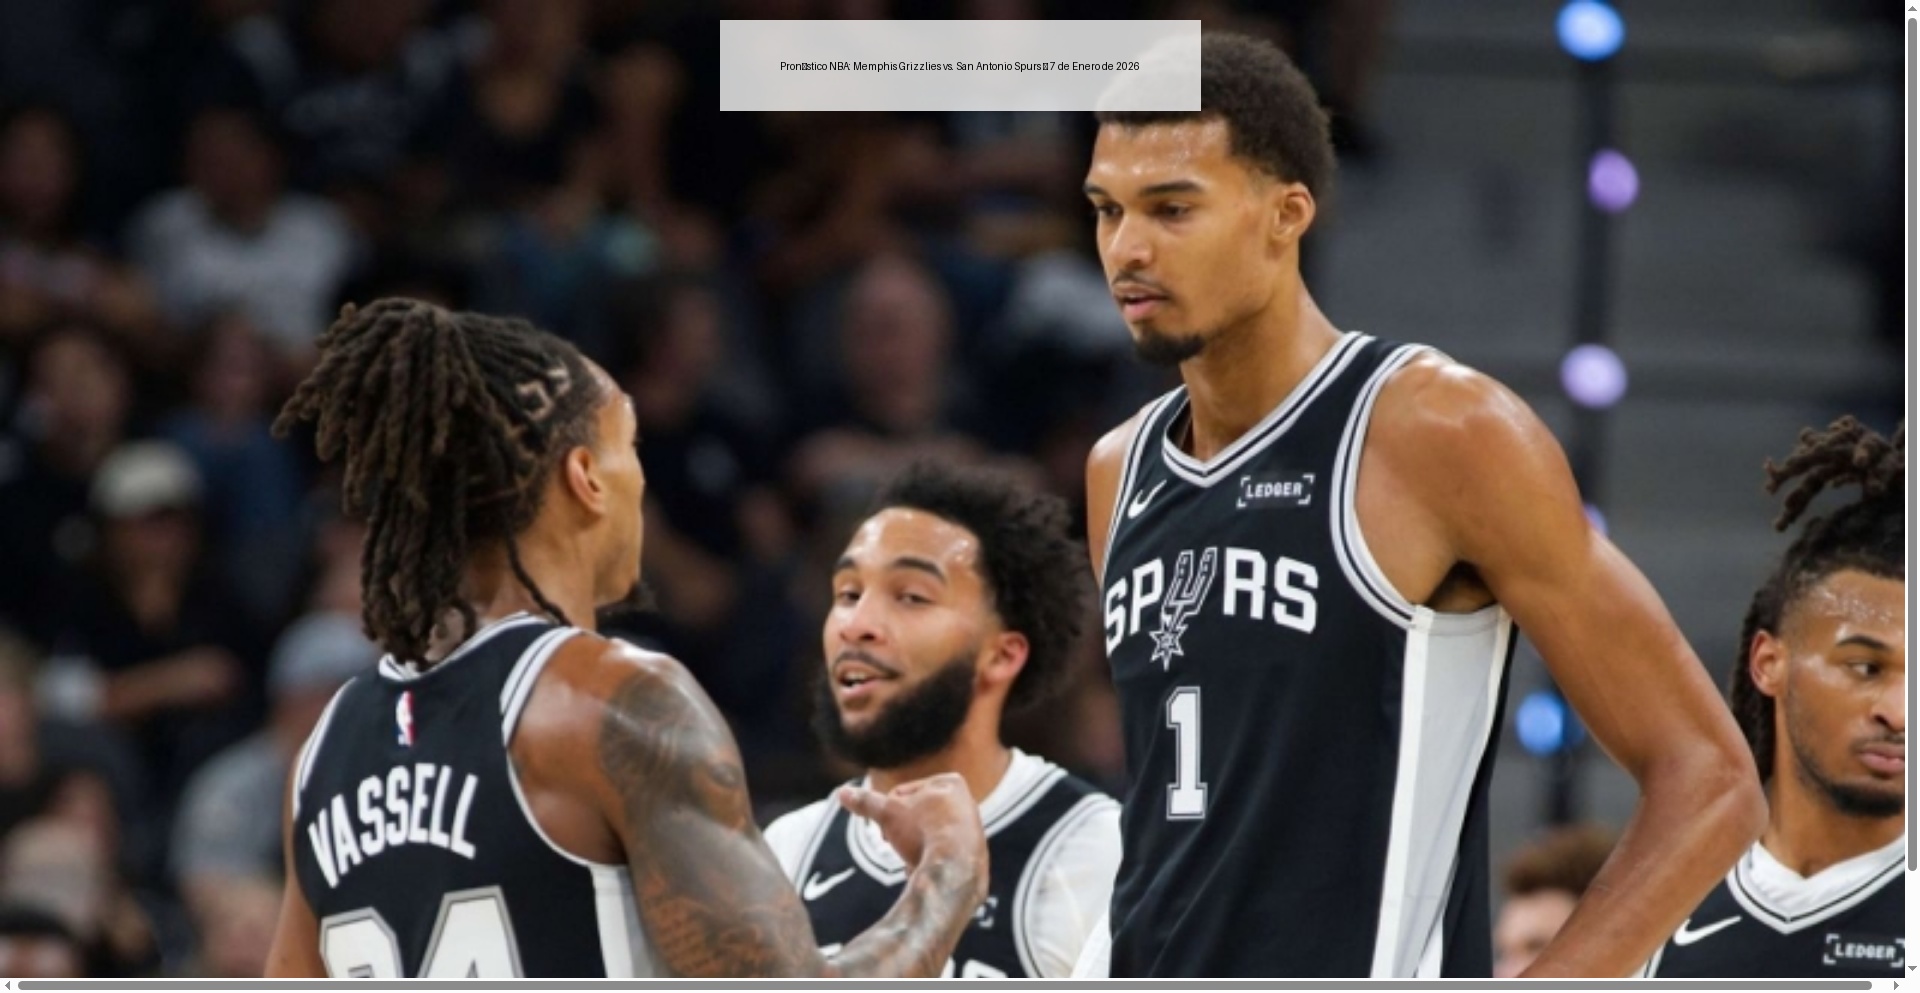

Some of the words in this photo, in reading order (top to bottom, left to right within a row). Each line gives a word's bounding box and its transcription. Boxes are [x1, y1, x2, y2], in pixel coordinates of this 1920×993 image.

[1244, 481, 1303, 499] LEDGER
[1104, 546, 1319, 671] SPURS
[1166, 686, 1208, 821] 1
[307, 762, 478, 889] VASSELL
[1833, 942, 1897, 960] LEDGER
